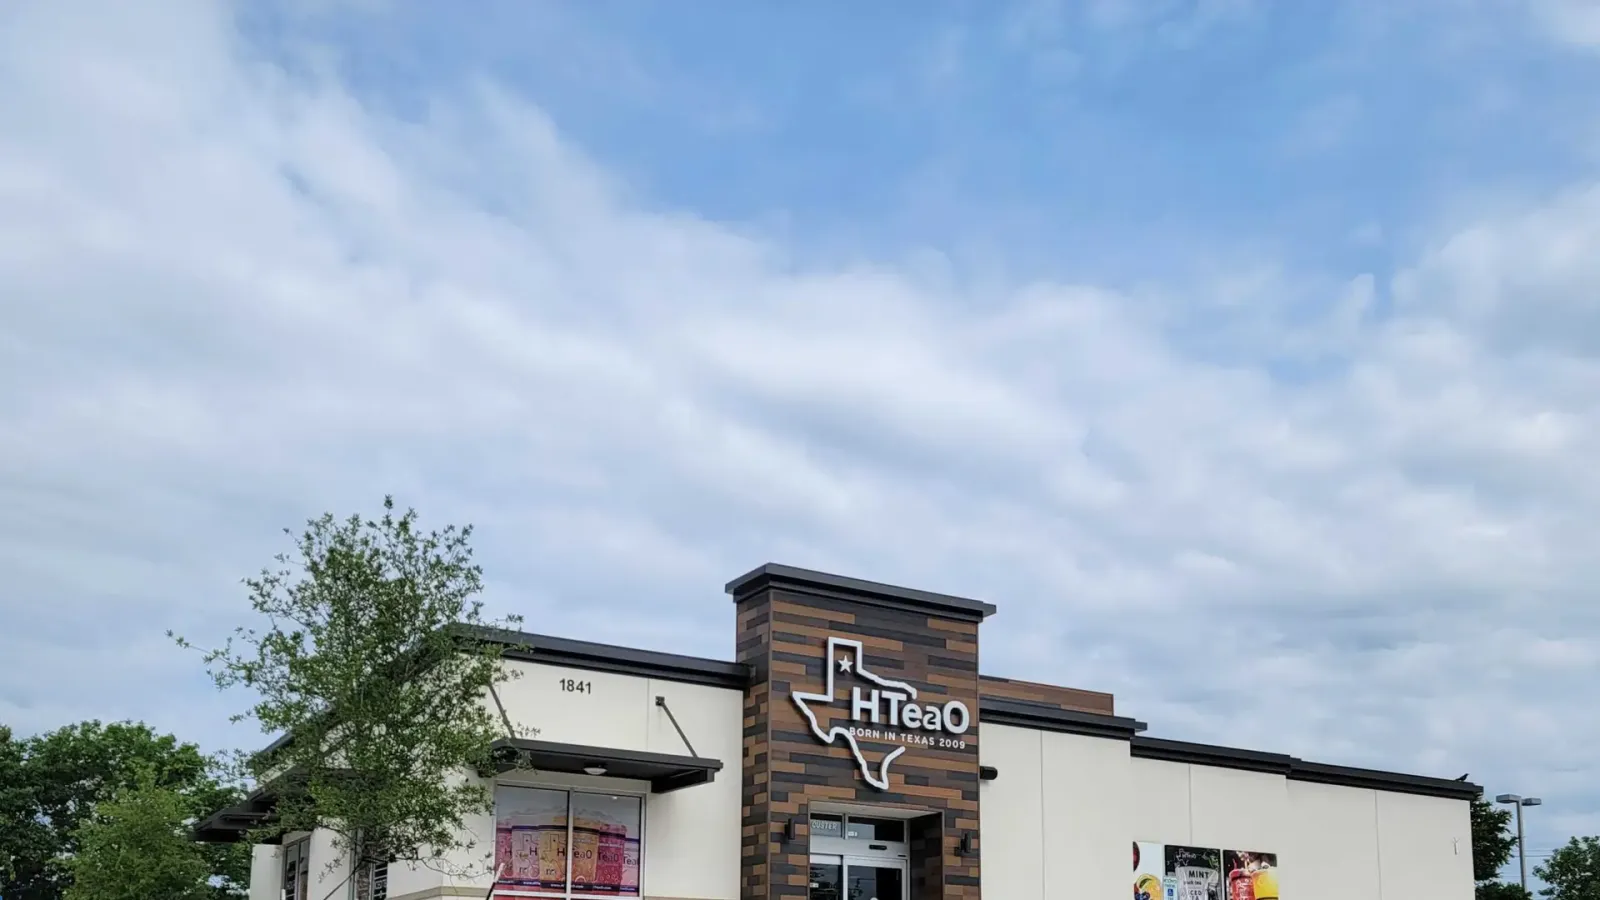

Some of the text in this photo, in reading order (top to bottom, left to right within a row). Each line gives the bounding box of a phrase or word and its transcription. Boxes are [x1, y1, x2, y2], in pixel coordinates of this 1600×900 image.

[559, 678, 591, 694] 1841
[852, 686, 970, 734] HTeaO
[849, 726, 966, 749] BORN IN TEXAS 2009
[1189, 870, 1209, 879] MINT
